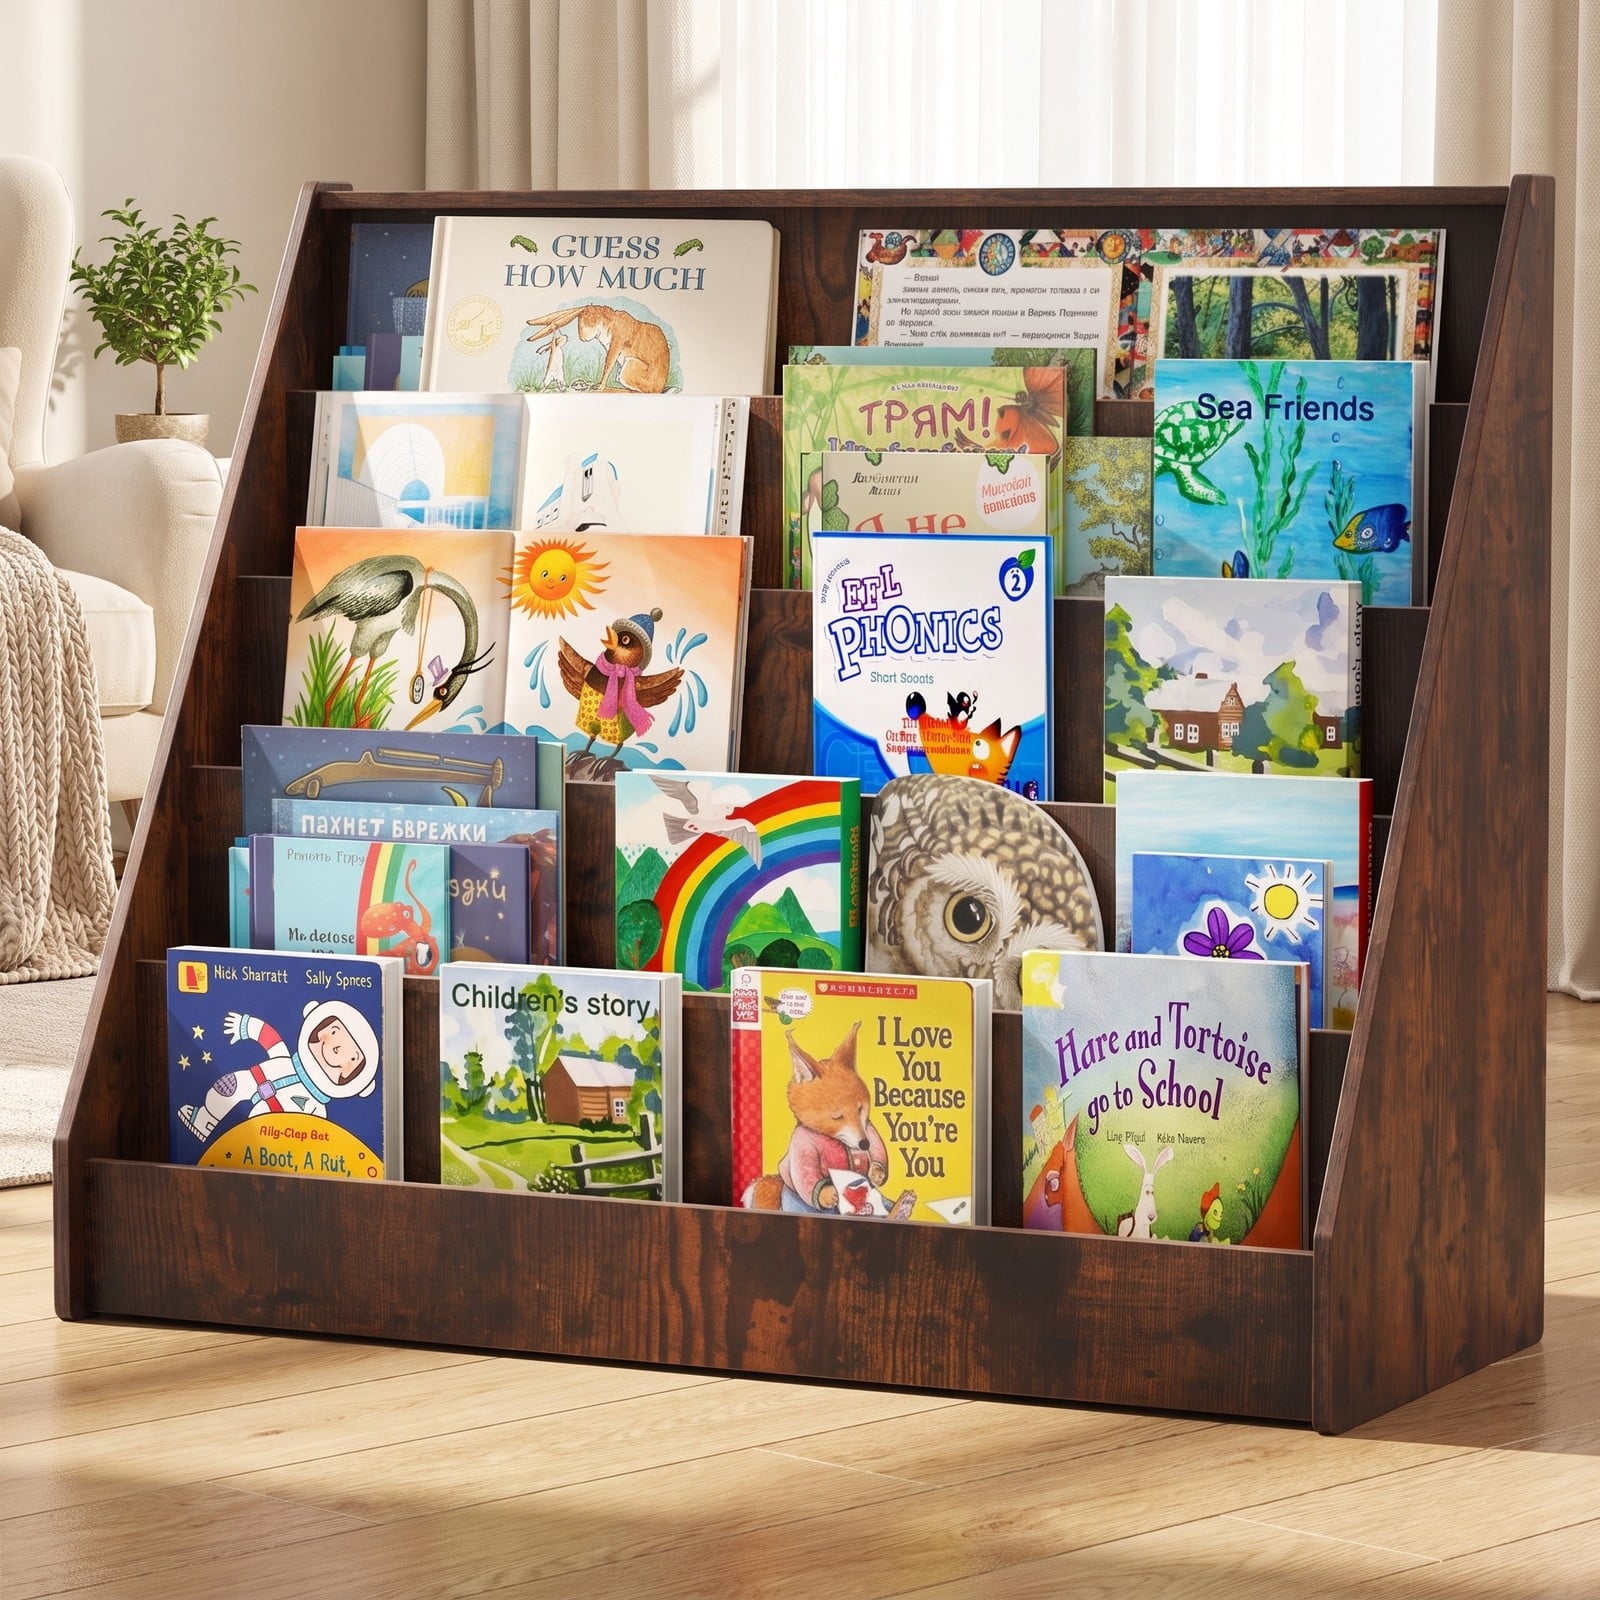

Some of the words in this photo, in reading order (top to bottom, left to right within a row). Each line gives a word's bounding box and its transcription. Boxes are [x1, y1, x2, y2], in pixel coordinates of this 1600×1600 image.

[551, 234, 661, 260] GUESS
[504, 264, 588, 289] HOW
[597, 265, 706, 291] MUCH
[858, 396, 991, 439] ТРЯМ!
[1197, 392, 1252, 420] Sea
[1265, 393, 1374, 422] Friends
[842, 564, 902, 613] EFL
[1011, 573, 1021, 592] 2
[828, 605, 1003, 682] PHONICS
[214, 964, 238, 980] Nick
[242, 966, 288, 984] Sharratt
[305, 969, 332, 989] Sally
[587, 993, 651, 1023] story
[877, 1016, 887, 1046] I
[893, 1016, 952, 1049] Love
[1055, 1027, 1120, 1088] Hare
[1125, 1016, 1162, 1051] and
[1168, 1002, 1272, 1085] Tortoise
[896, 1051, 942, 1082] You
[873, 1077, 966, 1109] Because
[1087, 1091, 1109, 1135] go
[1113, 1081, 1133, 1109] to
[1137, 1058, 1223, 1120] School
[883, 1112, 958, 1143] You're
[243, 1146, 254, 1166] A
[260, 1147, 298, 1172] Boot,
[304, 1151, 314, 1170] A
[899, 1147, 945, 1178] You
